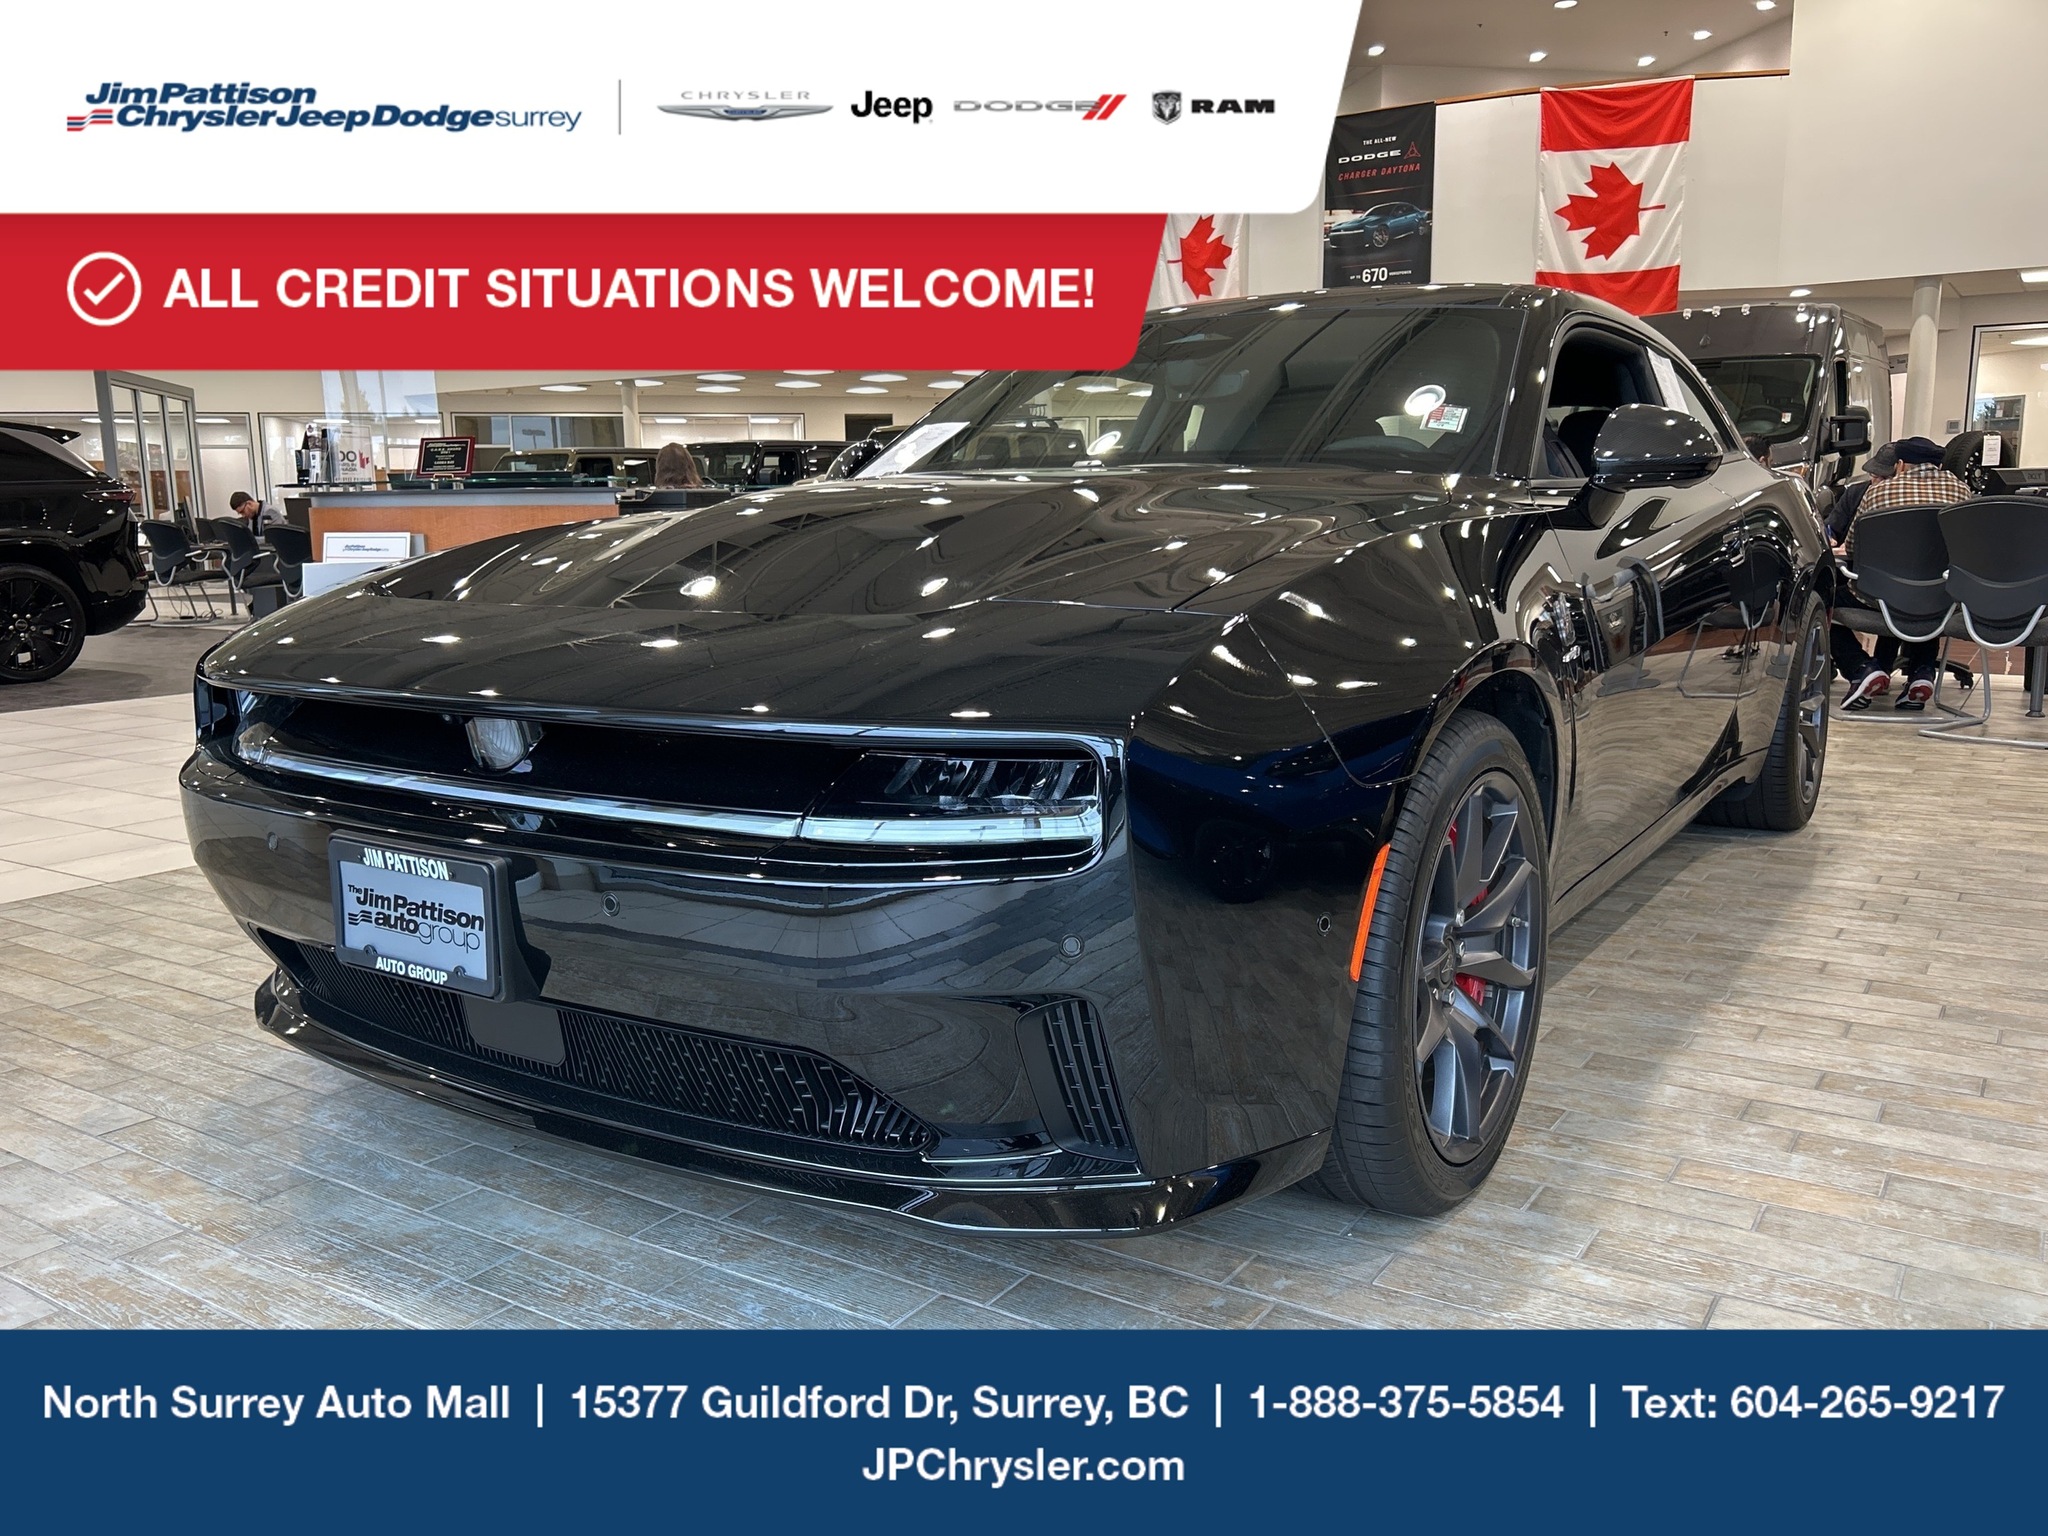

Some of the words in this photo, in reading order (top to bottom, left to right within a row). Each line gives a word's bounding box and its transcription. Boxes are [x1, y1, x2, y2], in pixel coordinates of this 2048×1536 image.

[1374, 136, 1397, 144] ALL-NEW
[1338, 149, 1401, 164] DODGE
[1338, 168, 1378, 181] CHARGER
[1380, 162, 1421, 176] DAYTONA
[1362, 267, 1388, 283] 670
[363, 848, 385, 868] JIM
[385, 851, 450, 881] PATTISON
[347, 884, 363, 895] The
[375, 956, 406, 976] AUTO
[407, 963, 448, 986] GROUP
